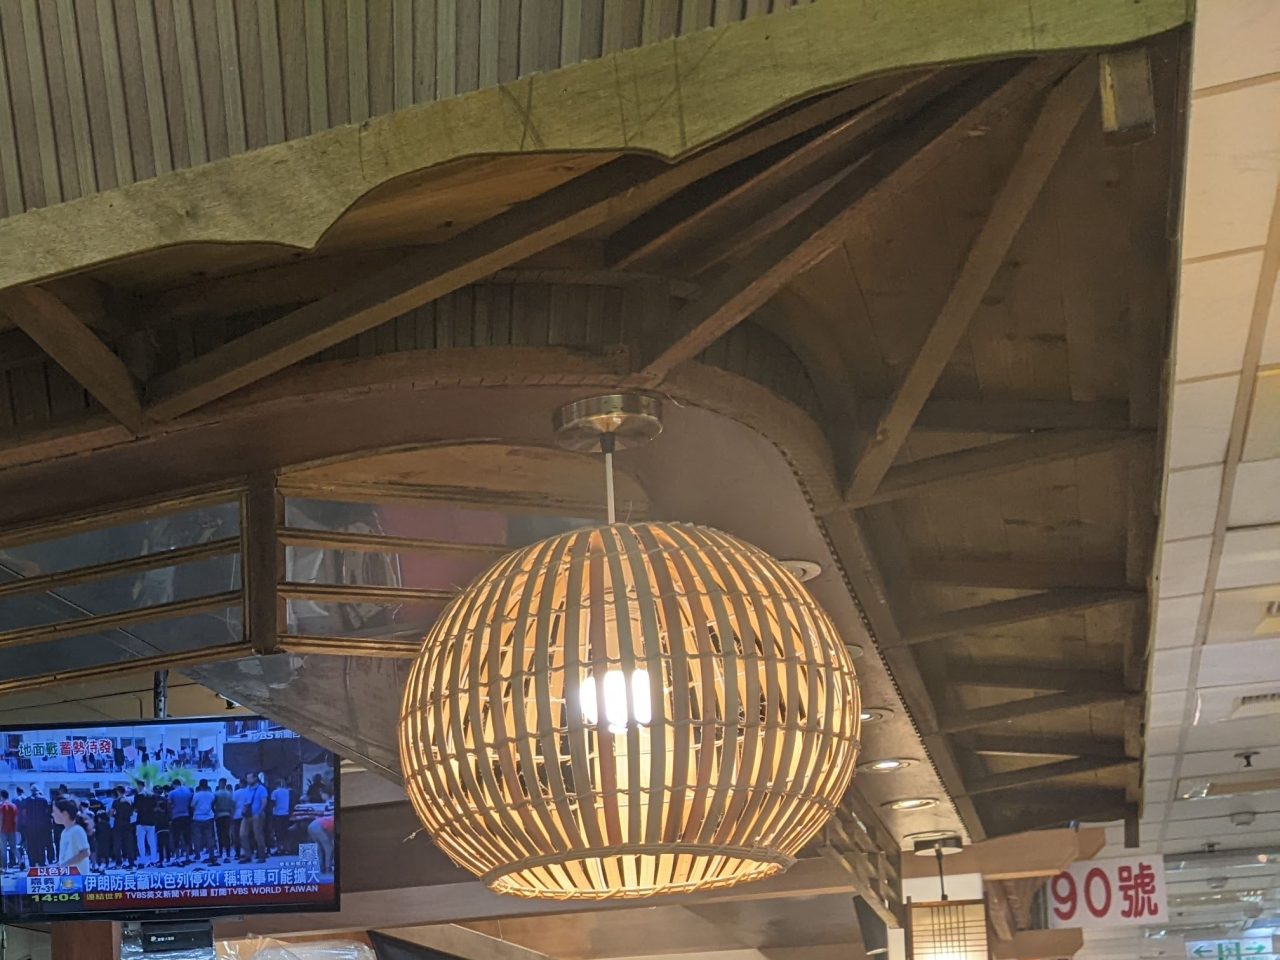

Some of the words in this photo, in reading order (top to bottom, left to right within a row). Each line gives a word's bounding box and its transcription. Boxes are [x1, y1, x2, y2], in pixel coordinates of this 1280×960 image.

[19, 739, 112, 757] 地面戰蓄勢待發
[37, 867, 70, 877] 以色列
[251, 886, 282, 895] WORLD
[285, 884, 319, 893] TAIWAN
[1051, 862, 1159, 921] 90號
[32, 893, 81, 902] 14:04
